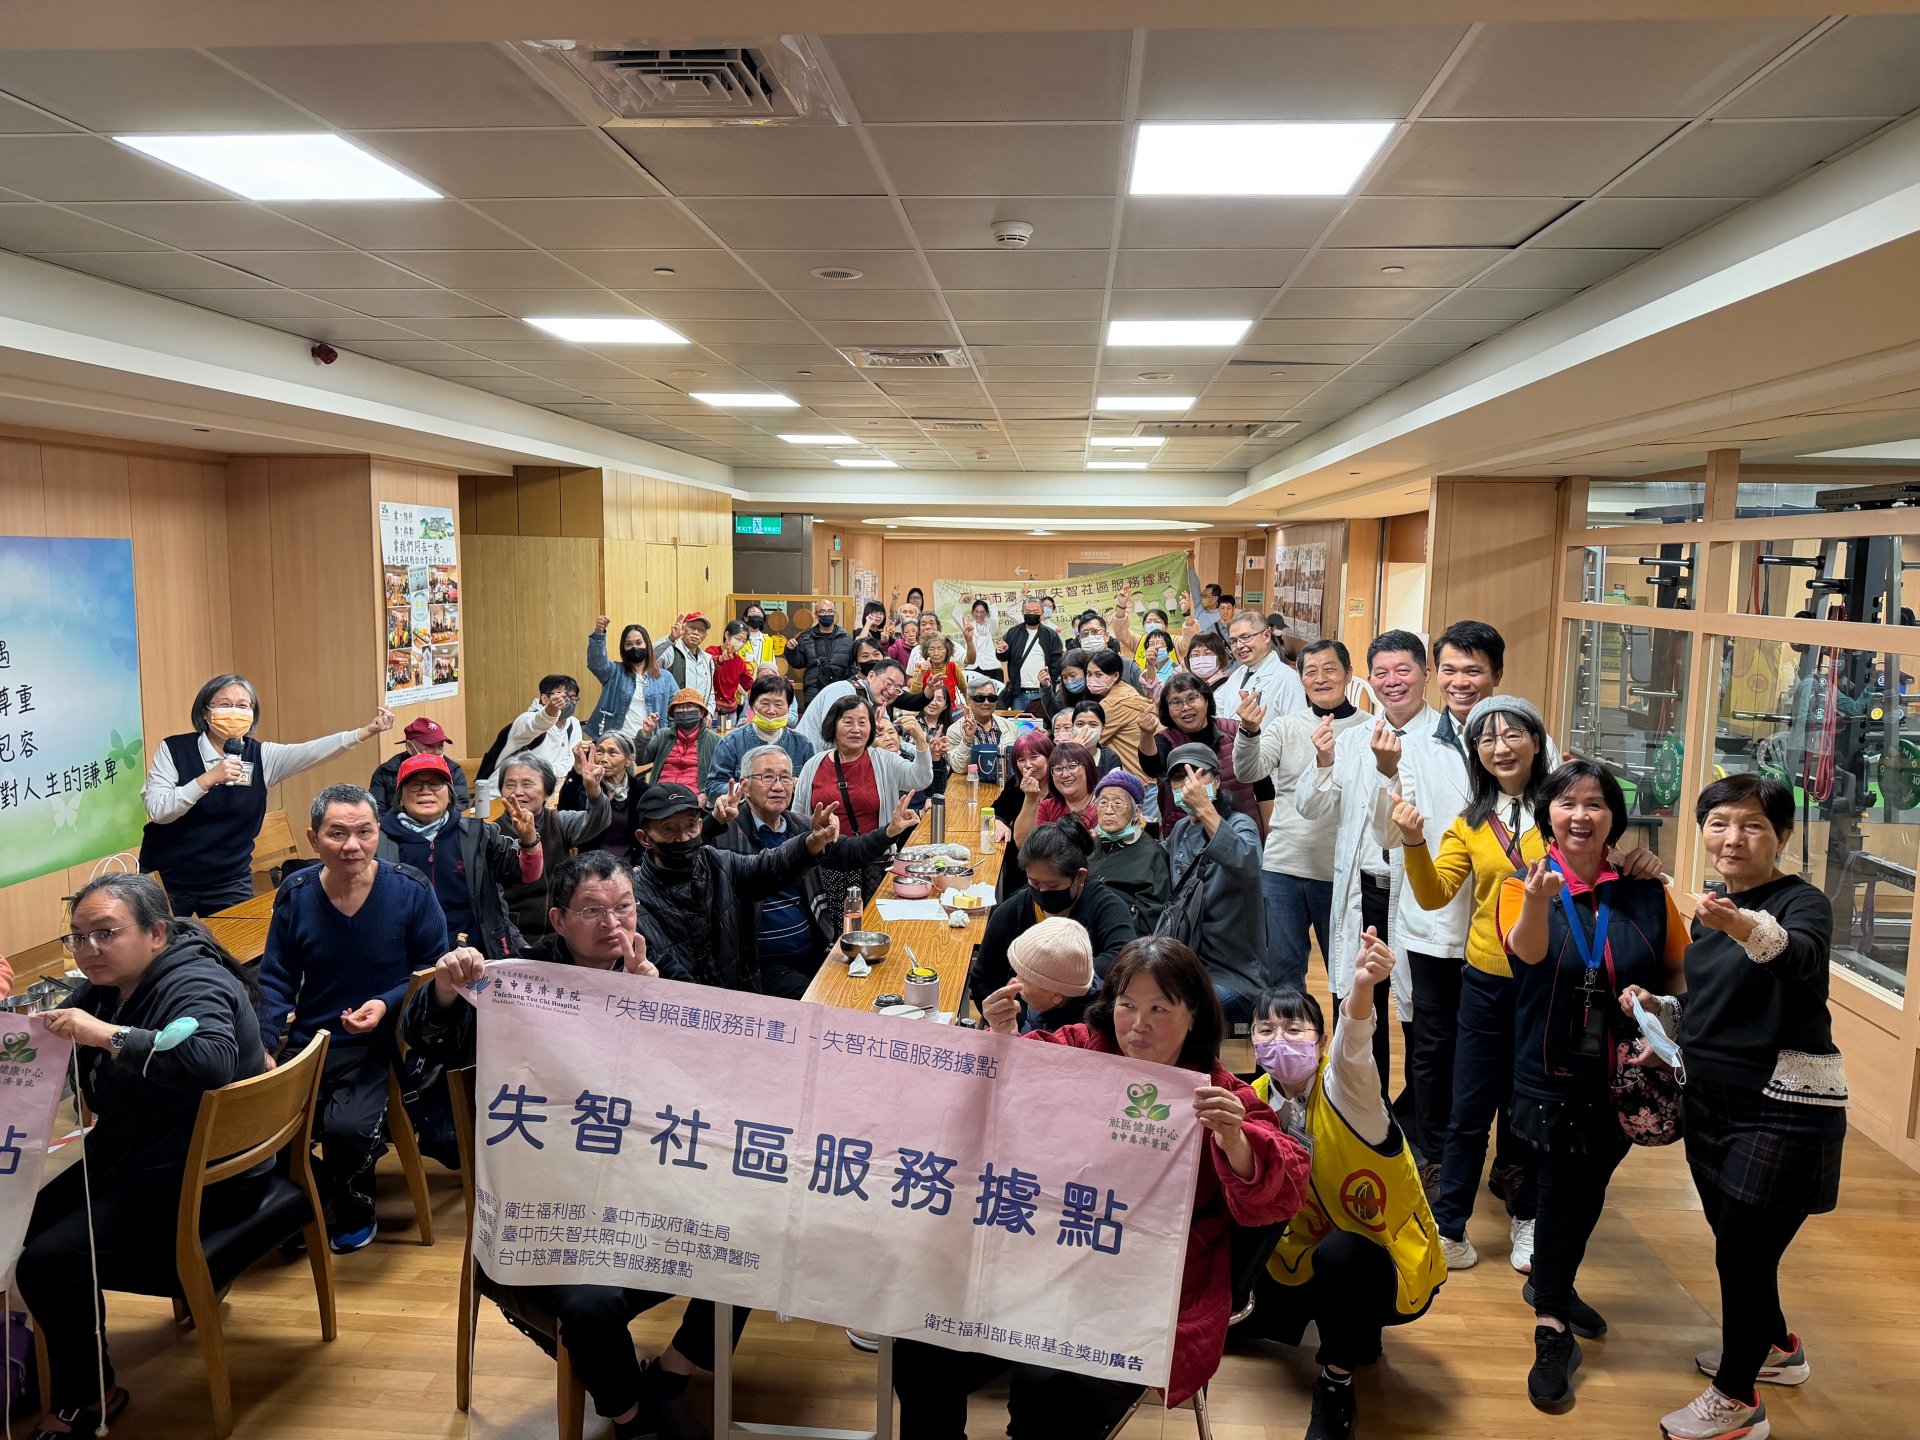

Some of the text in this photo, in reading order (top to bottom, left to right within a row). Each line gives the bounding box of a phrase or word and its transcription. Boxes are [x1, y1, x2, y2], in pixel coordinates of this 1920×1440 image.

[0, 731, 38, 762] 包容
[1, 758, 118, 810] 對人生的謙卑
[1877, 872, 1914, 890] MATRIX
[493, 991, 525, 1001] Taichung
[526, 995, 538, 1003] Tzu
[539, 997, 550, 1005] Chi
[495, 977, 580, 1002] 台中慈濟醫院
[1108, 1116, 1179, 1141] 社區健康中心
[1111, 1131, 1171, 1152] 台中慈濟醫院
[486, 1084, 1128, 1255] 失智社區服務據點
[498, 1248, 693, 1278] 台中慈濟醫院失智服務據點
